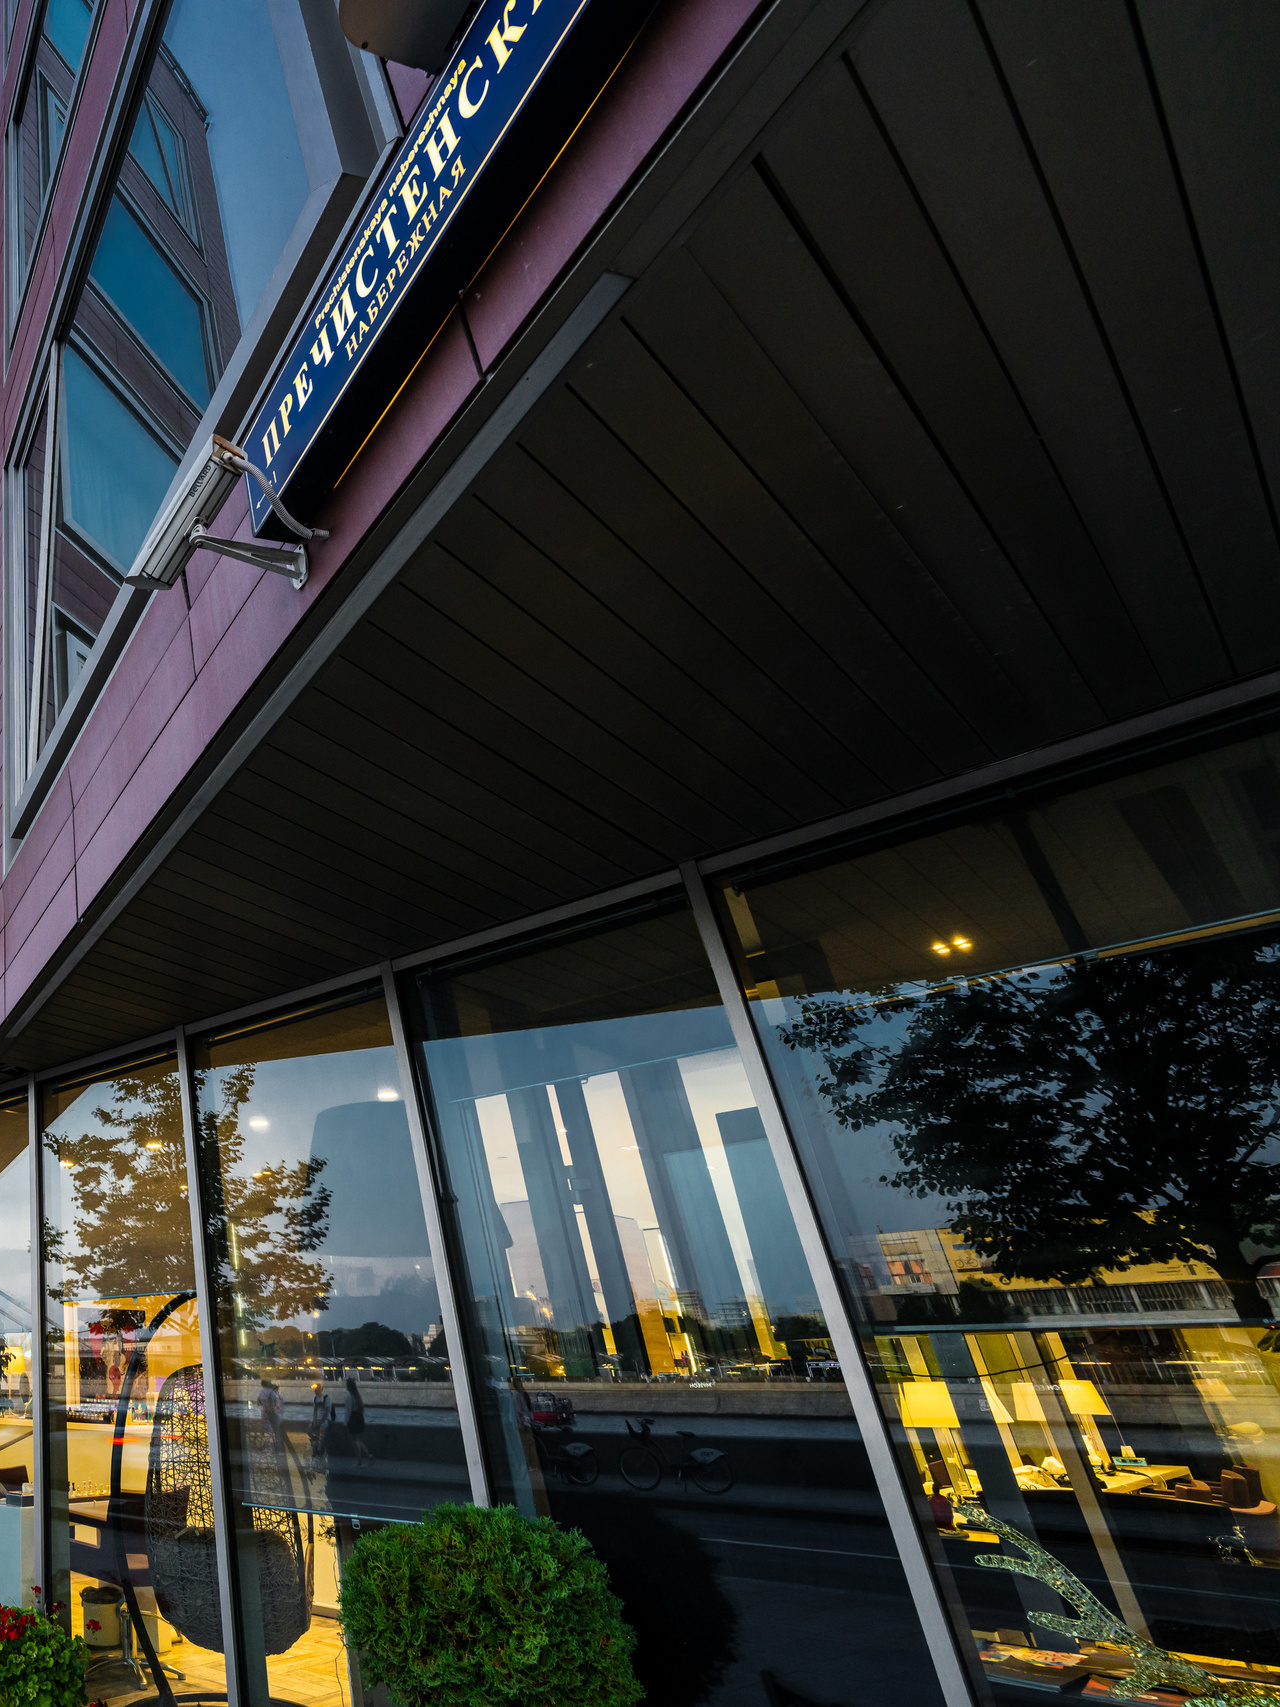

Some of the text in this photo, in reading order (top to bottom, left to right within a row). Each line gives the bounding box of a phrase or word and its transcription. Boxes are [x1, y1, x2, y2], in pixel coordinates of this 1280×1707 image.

[261, 0, 543, 469] ПРЕЧИСТЕНСК
[315, 59, 467, 330] Prechistenskaya naberezhnaya
[344, 154, 467, 361] НАБЕРЕЖНАЯ
